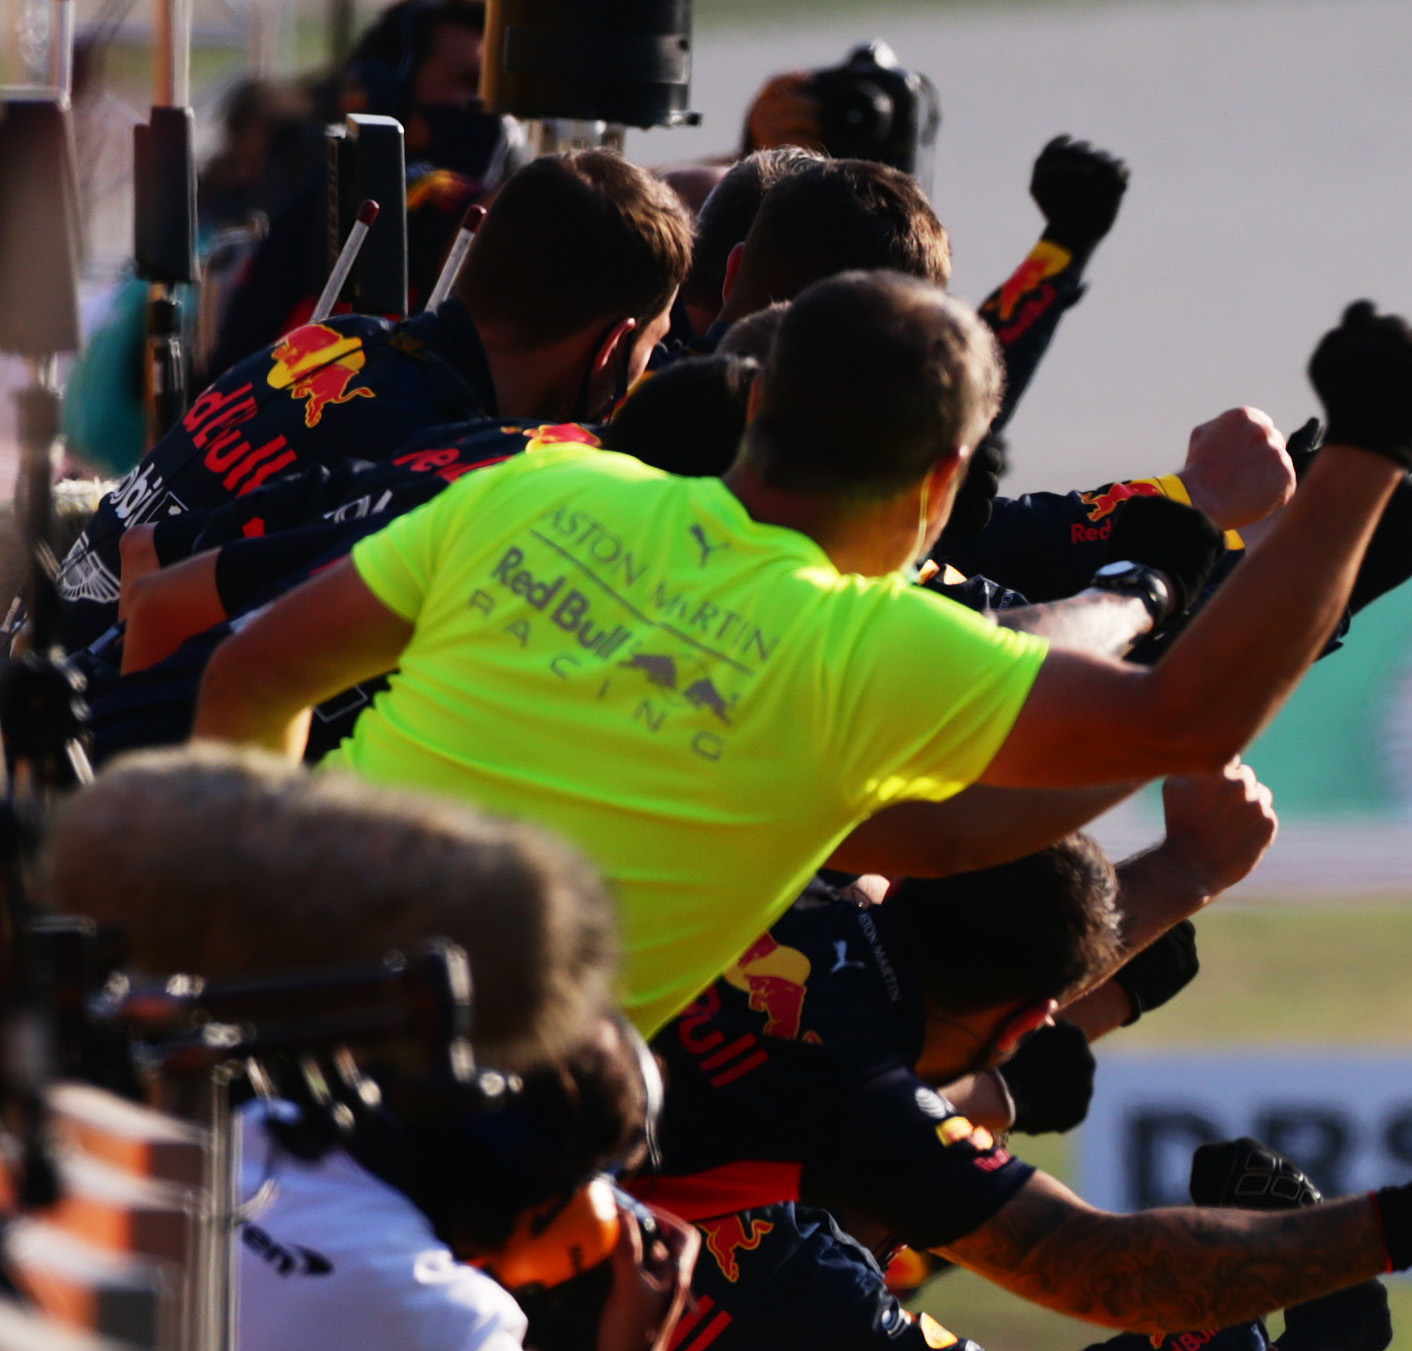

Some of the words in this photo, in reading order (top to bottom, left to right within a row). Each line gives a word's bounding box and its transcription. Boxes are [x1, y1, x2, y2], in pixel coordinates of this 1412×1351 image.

[1070, 519, 1113, 544] Red
[545, 504, 648, 588] ASTON
[654, 579, 781, 662] MARTIN
